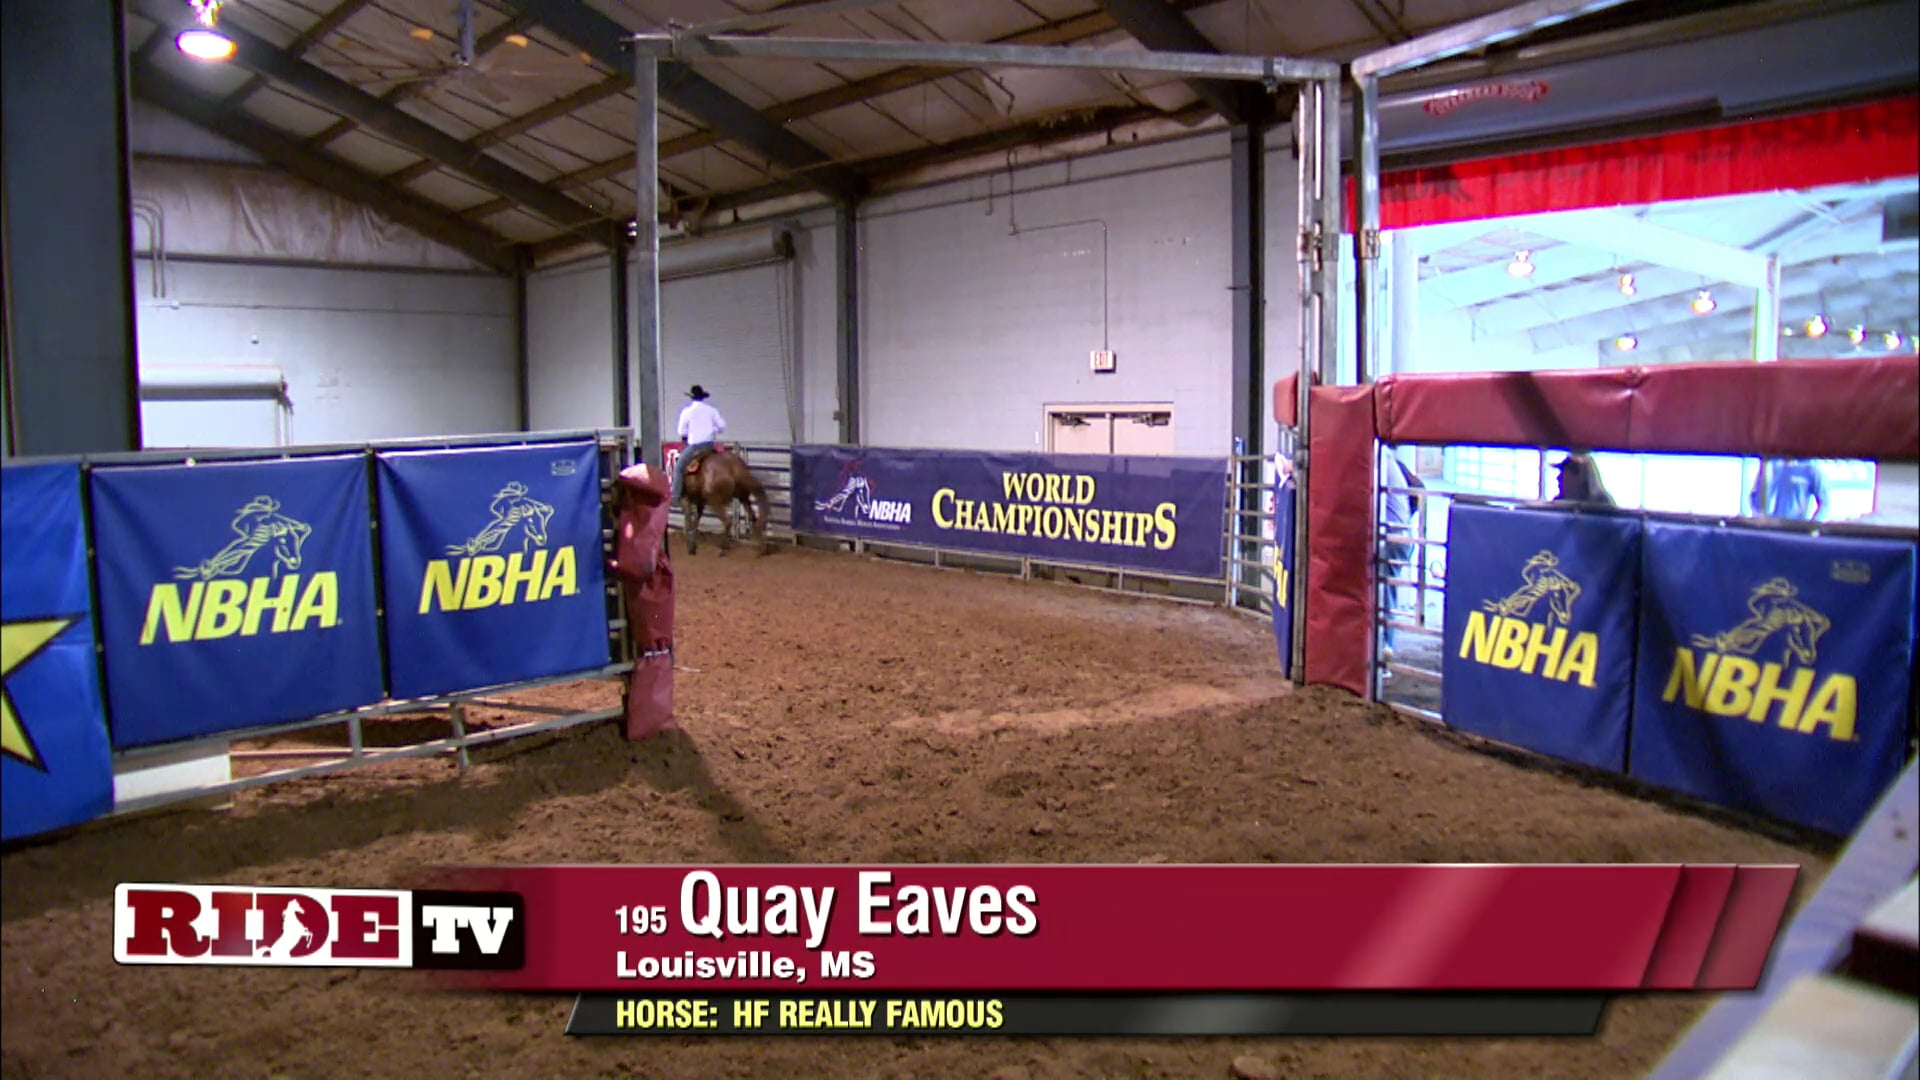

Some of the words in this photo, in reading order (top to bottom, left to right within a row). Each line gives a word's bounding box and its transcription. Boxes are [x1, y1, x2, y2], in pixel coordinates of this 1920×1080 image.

[868, 500, 911, 523] NBHA
[1002, 473, 1095, 505] WORLD
[141, 571, 338, 645] NBHA
[419, 546, 577, 614] NBHA
[1459, 611, 1598, 688] NBHA
[1662, 646, 1858, 740] NBHA
